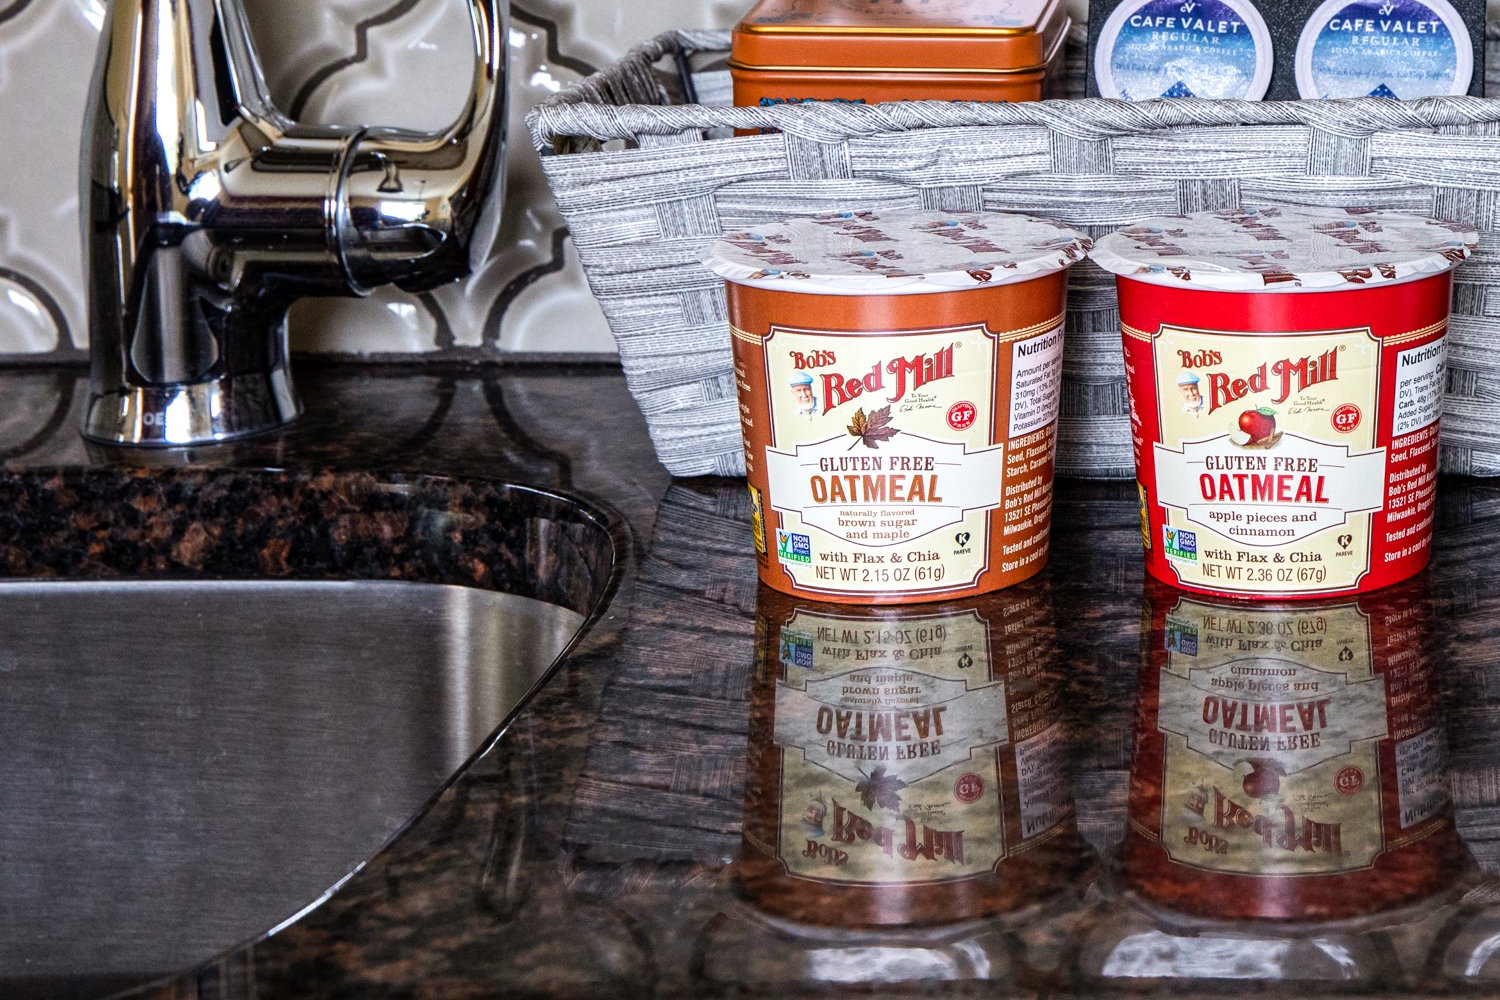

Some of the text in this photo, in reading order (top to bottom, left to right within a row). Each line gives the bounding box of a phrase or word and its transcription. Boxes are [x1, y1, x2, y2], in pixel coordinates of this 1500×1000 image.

[1130, 15, 1241, 33] CAFE VALET
[1329, 19, 1440, 34] CAFE VALET
[1151, 31, 1220, 44] REGULAR
[1351, 35, 1420, 46] REGULAR
[1017, 334, 1057, 358] Nutrition
[789, 350, 836, 369] Bob's
[1177, 350, 1222, 369] Bob's
[1401, 344, 1441, 368] Nutrition
[1016, 363, 1042, 379] Amount
[820, 360, 885, 416] Red
[886, 343, 955, 403] Mill
[1206, 362, 1270, 415] Red
[1271, 346, 1339, 404] Mill
[1400, 378, 1411, 390] per
[951, 410, 973, 422] GF
[1014, 408, 1036, 421] Vitamin
[1336, 413, 1357, 425] GF
[1397, 408, 1417, 420] Added
[820, 456, 935, 472] GLUTEN FREE
[1007, 453, 1025, 465] Seed,
[1205, 456, 1318, 472] GLUTEN FREE
[1390, 452, 1408, 464] Seed,
[1389, 465, 1421, 484] Distributed
[810, 474, 943, 504] OATMEAL
[1005, 478, 1037, 497] Distributed
[1199, 473, 1330, 504] OATMEAL
[1388, 479, 1417, 497] Bob's Red
[1005, 492, 1034, 510] Bob's Red
[1388, 495, 1406, 510] 13521
[880, 509, 915, 517] flavored
[1004, 509, 1023, 523] 13521
[1209, 510, 1317, 524] apple pieces and
[1386, 505, 1417, 524] Milwaukie,
[838, 518, 917, 528] brown sugar
[1003, 518, 1034, 537] Milwaukie,
[793, 534, 809, 542] NON
[846, 530, 910, 540] and maple
[1179, 531, 1195, 540] NON
[1229, 526, 1295, 537] cinnamon
[1385, 527, 1406, 543] Tested
[793, 541, 809, 549] GMO
[1002, 540, 1023, 556] Tested
[1180, 539, 1195, 547] GMO
[779, 550, 810, 562] VERIFIED
[820, 550, 940, 563] with Flax & Chia
[1165, 547, 1196, 560] VERIFIED
[1204, 549, 1232, 561] with
[1236, 551, 1268, 563] Flax
[1273, 552, 1285, 563] &
[1289, 551, 1322, 562] Chia
[1384, 546, 1401, 563] Store
[1001, 557, 1019, 573] Store
[816, 564, 945, 582] NET WT 2.15 OZ (61g)
[1202, 563, 1327, 583] NET WT 2.36 OZ (67g)
